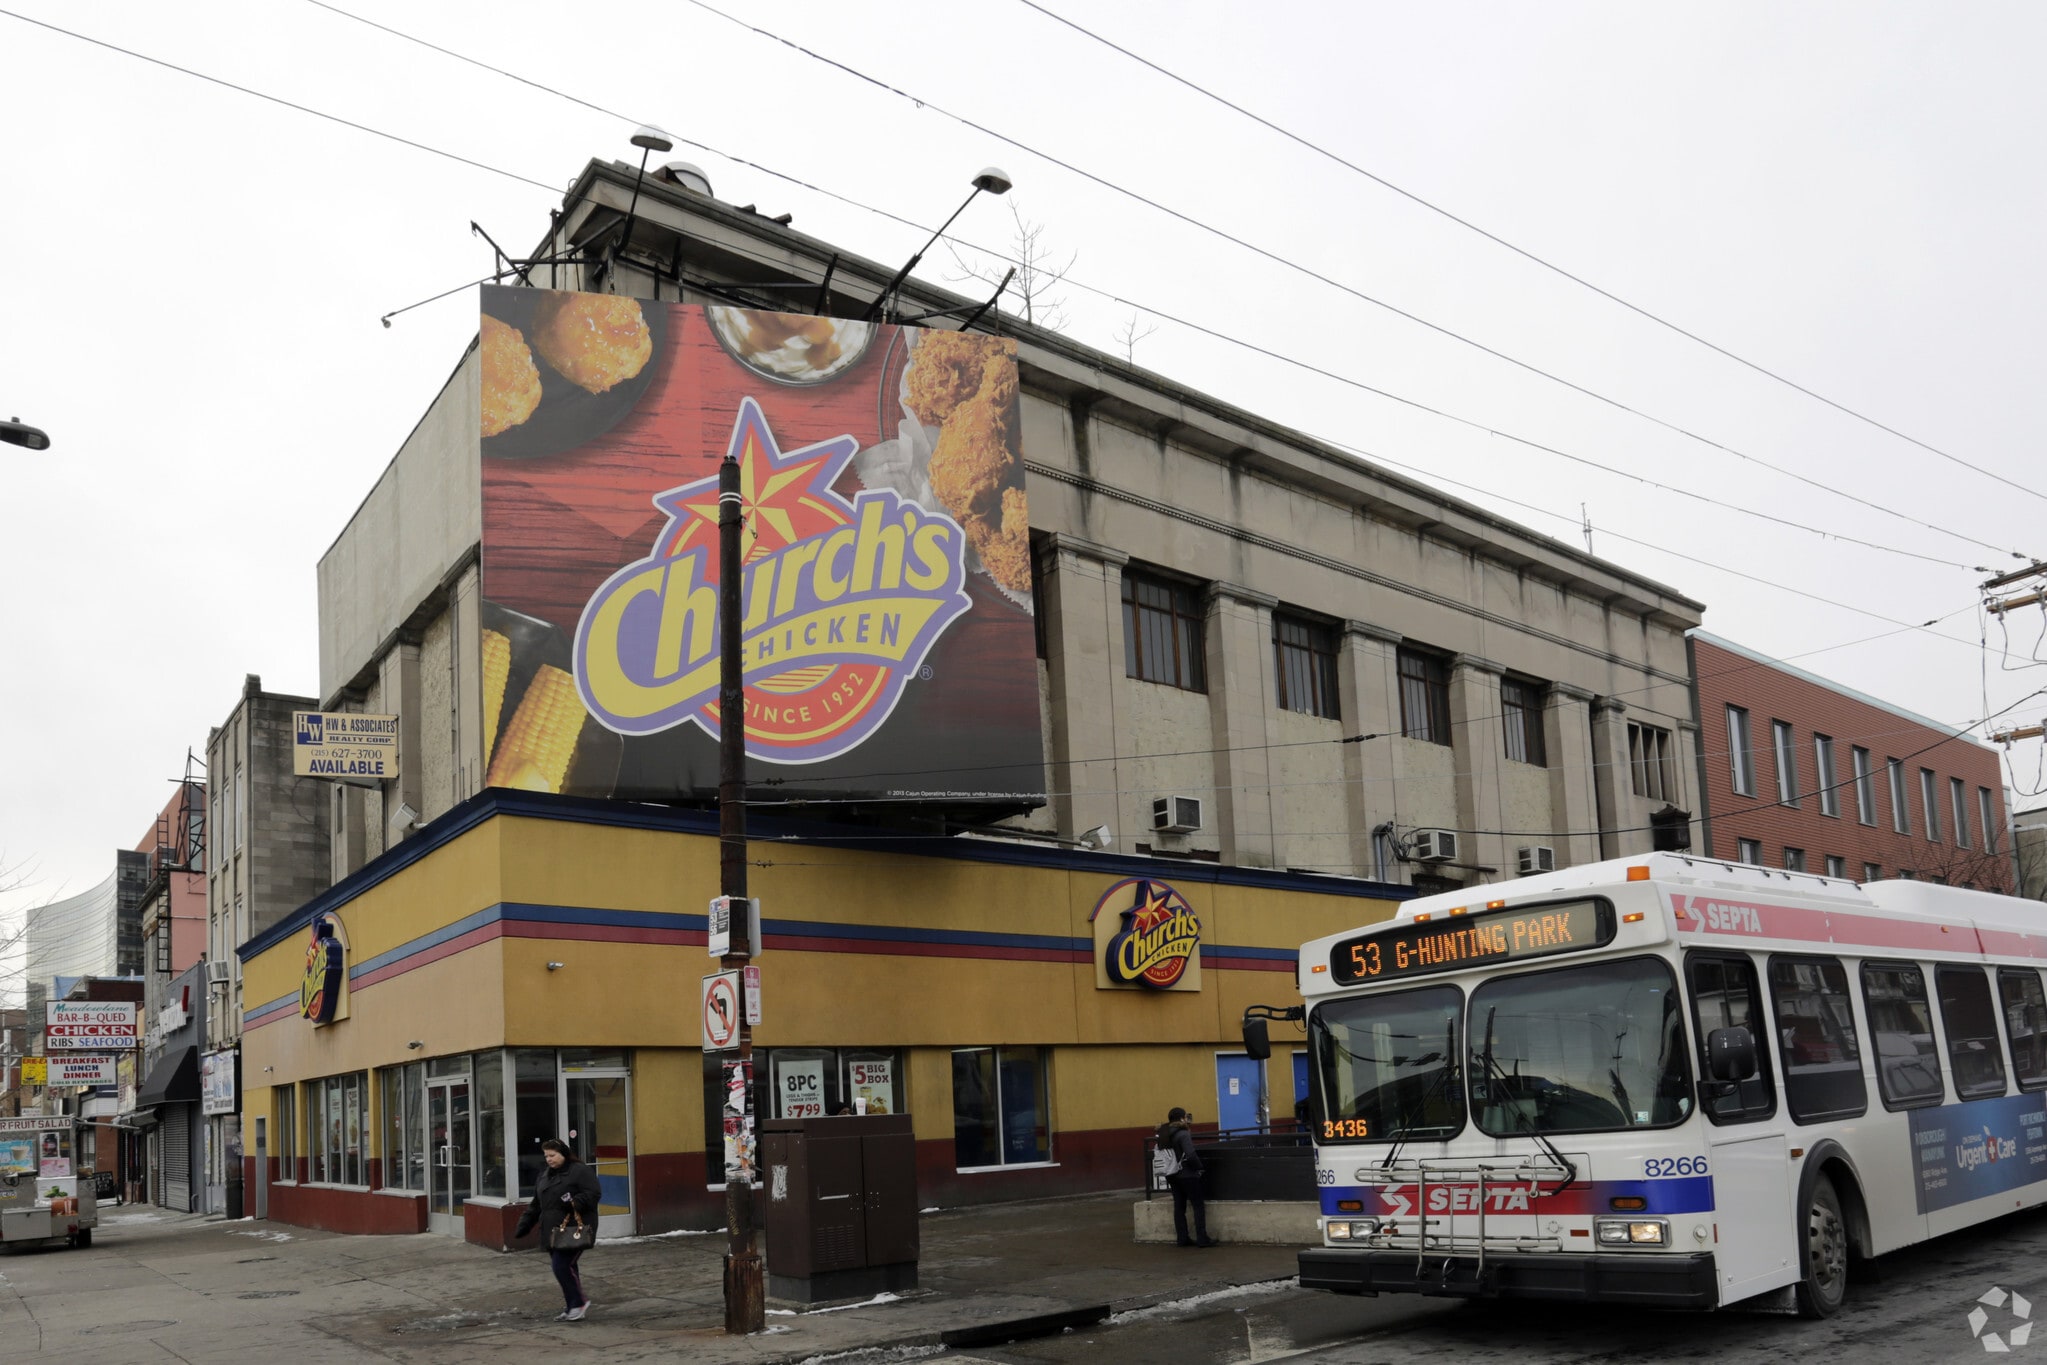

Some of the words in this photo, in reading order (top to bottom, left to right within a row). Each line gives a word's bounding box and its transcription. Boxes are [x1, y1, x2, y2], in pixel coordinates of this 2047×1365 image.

[586, 500, 950, 718] Church's
[822, 673, 863, 712] 1952
[326, 718, 338, 730] HW
[341, 719, 346, 731] &
[350, 720, 395, 733] ASSOCIATES
[311, 749, 329, 757] (215)
[331, 749, 382, 759] 627-3700
[309, 759, 384, 775] AVAILABLE
[1707, 902, 1762, 933] SEPTA
[1118, 909, 1198, 980] Church's
[1151, 942, 1188, 962] CHICKEN
[1351, 942, 1382, 977] 53
[1396, 924, 1507, 970] G-HUNTING
[1512, 912, 1574, 950] PARK
[57, 1013, 126, 1024] BAR-B-QUED
[50, 1025, 134, 1036] CHICKEN
[51, 1038, 74, 1047] RIBS
[79, 1037, 133, 1046] SEAFOOD
[52, 1057, 110, 1065] BREAKFAST
[866, 1065, 886, 1073] BIG
[787, 1074, 817, 1091] 8PC
[867, 1075, 889, 1083] BOX
[8, 1120, 36, 1131] FRUIT
[38, 1119, 71, 1129] SALAD
[1323, 1119, 1367, 1138] 3436
[1956, 1141, 1988, 1170] Urgent
[1997, 1137, 2016, 1159] Care
[1644, 1155, 1709, 1178] 8266
[1428, 1187, 1530, 1211] SEPTA
